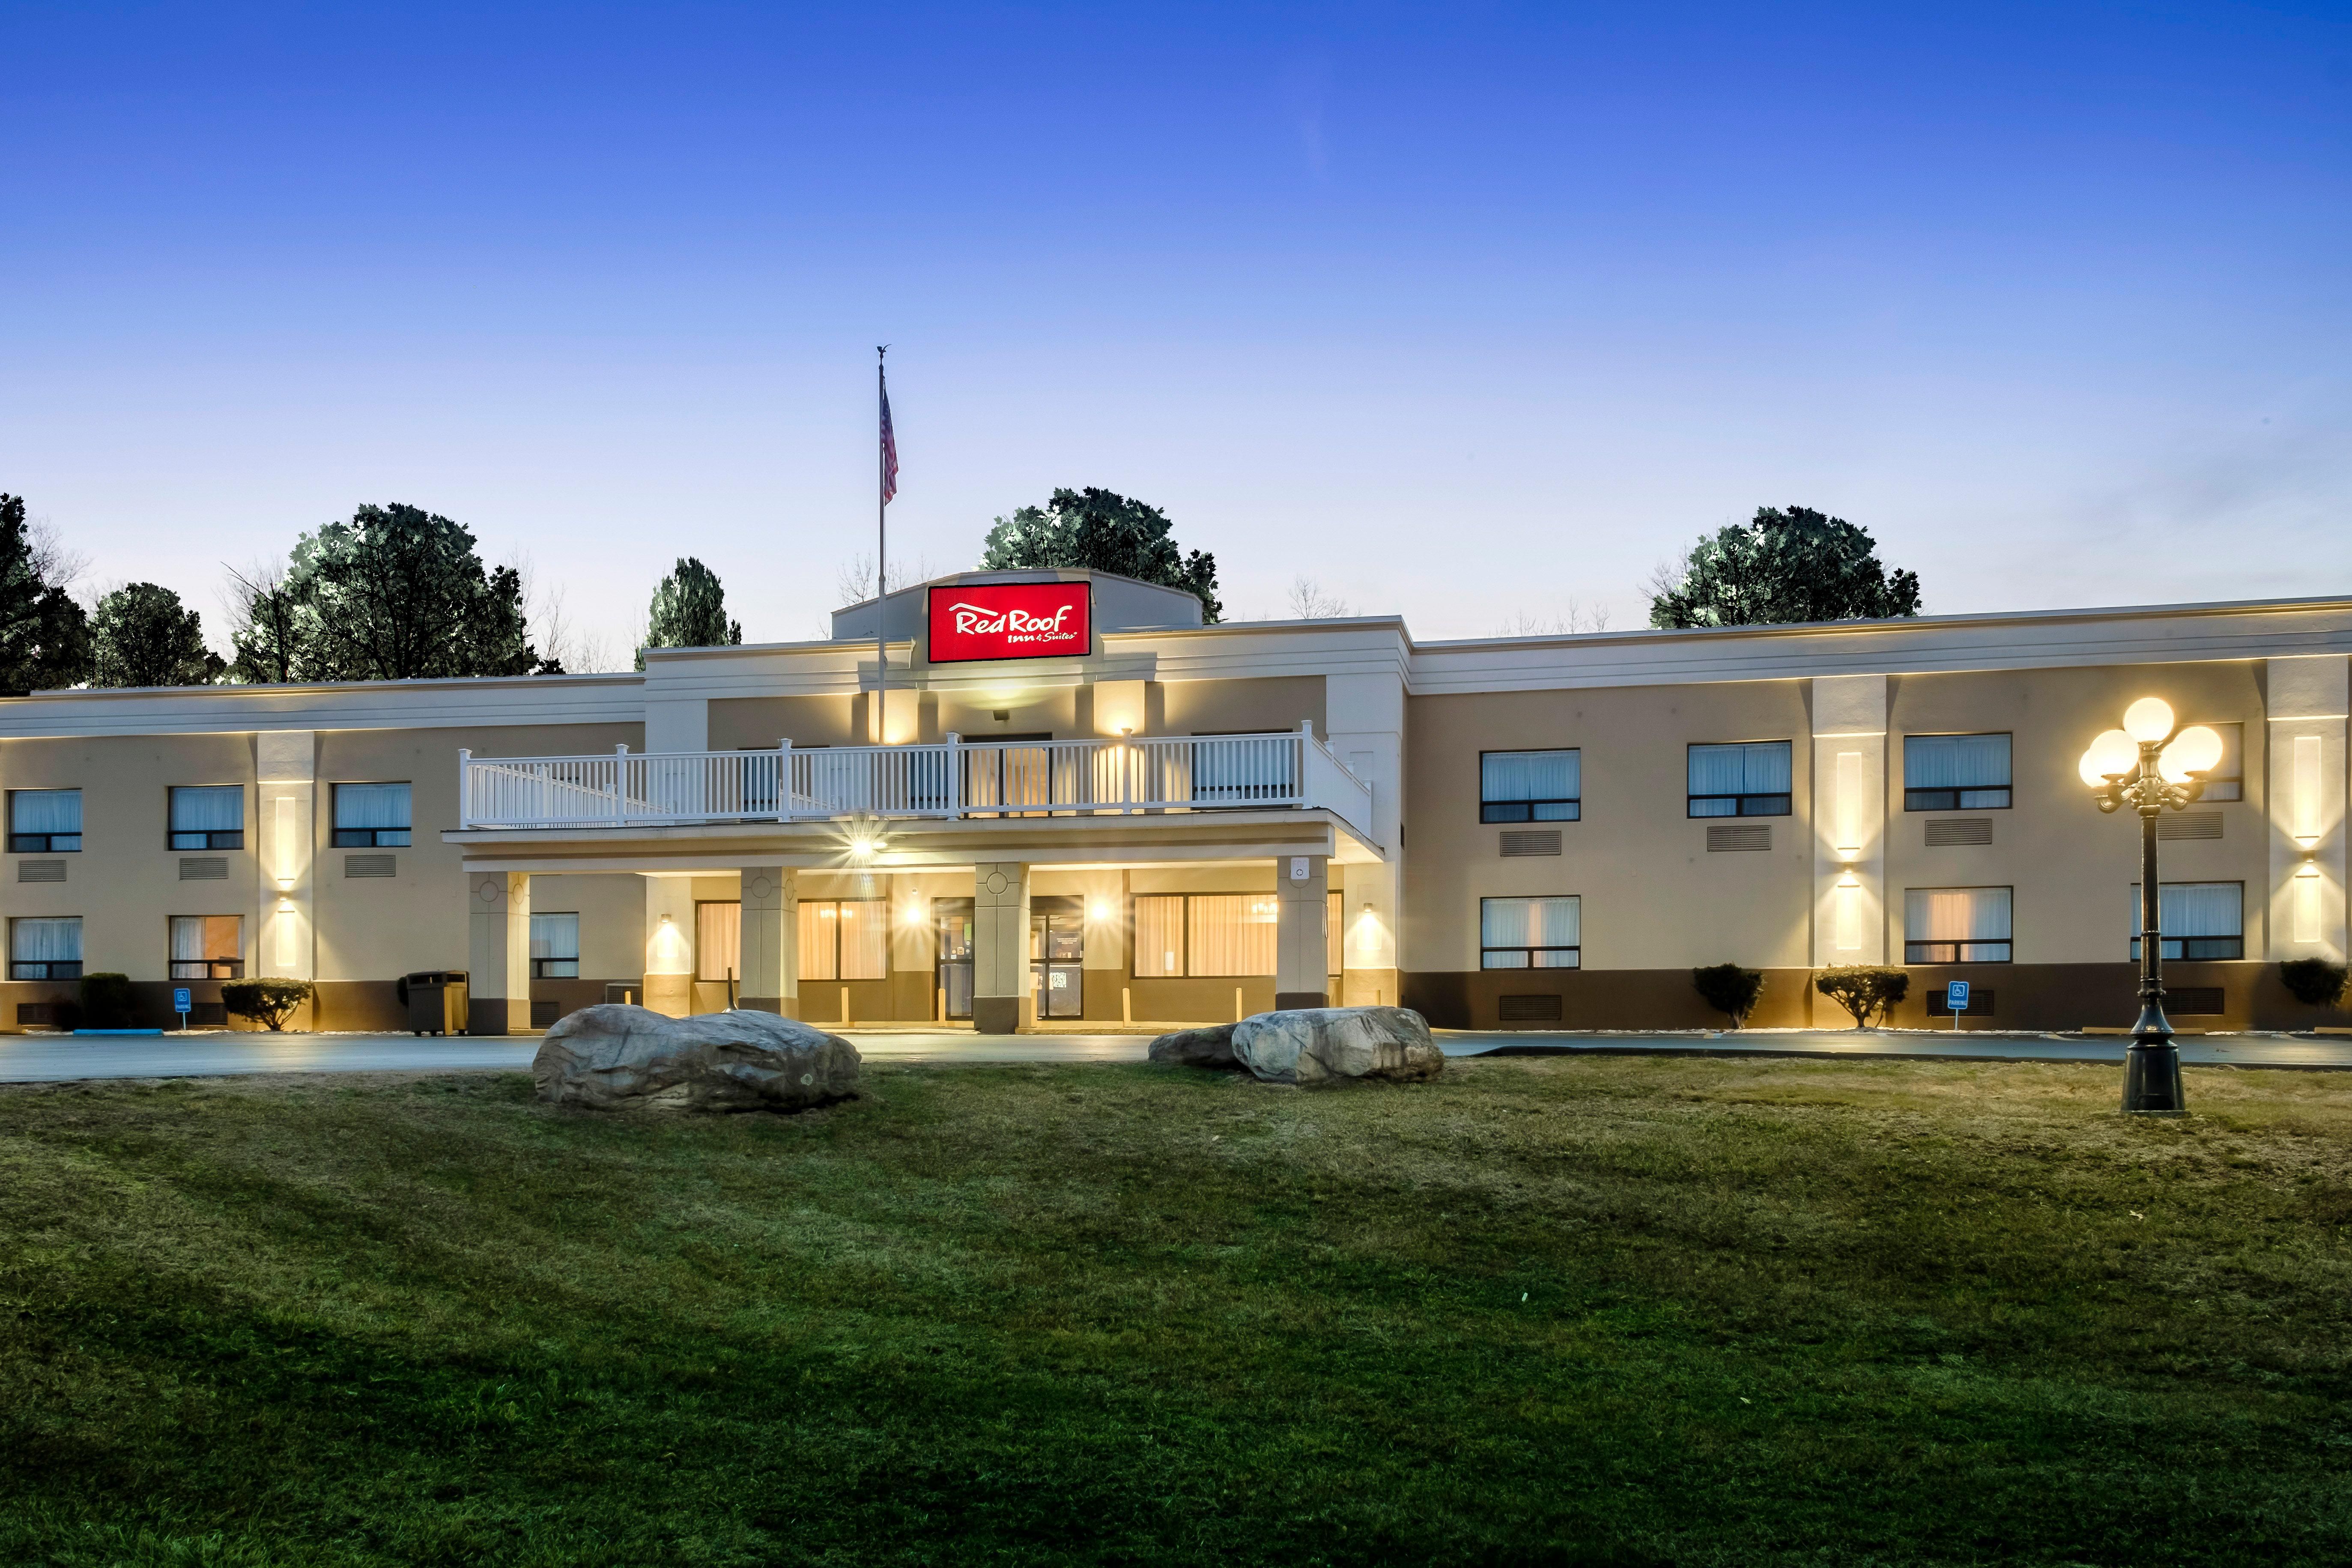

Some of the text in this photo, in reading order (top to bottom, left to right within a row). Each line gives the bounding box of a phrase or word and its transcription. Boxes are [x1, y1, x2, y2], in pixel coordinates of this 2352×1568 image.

[956, 605, 1073, 635] Red Roof
[1007, 635, 1035, 643] Inn
[1042, 631, 1075, 642] Suites
